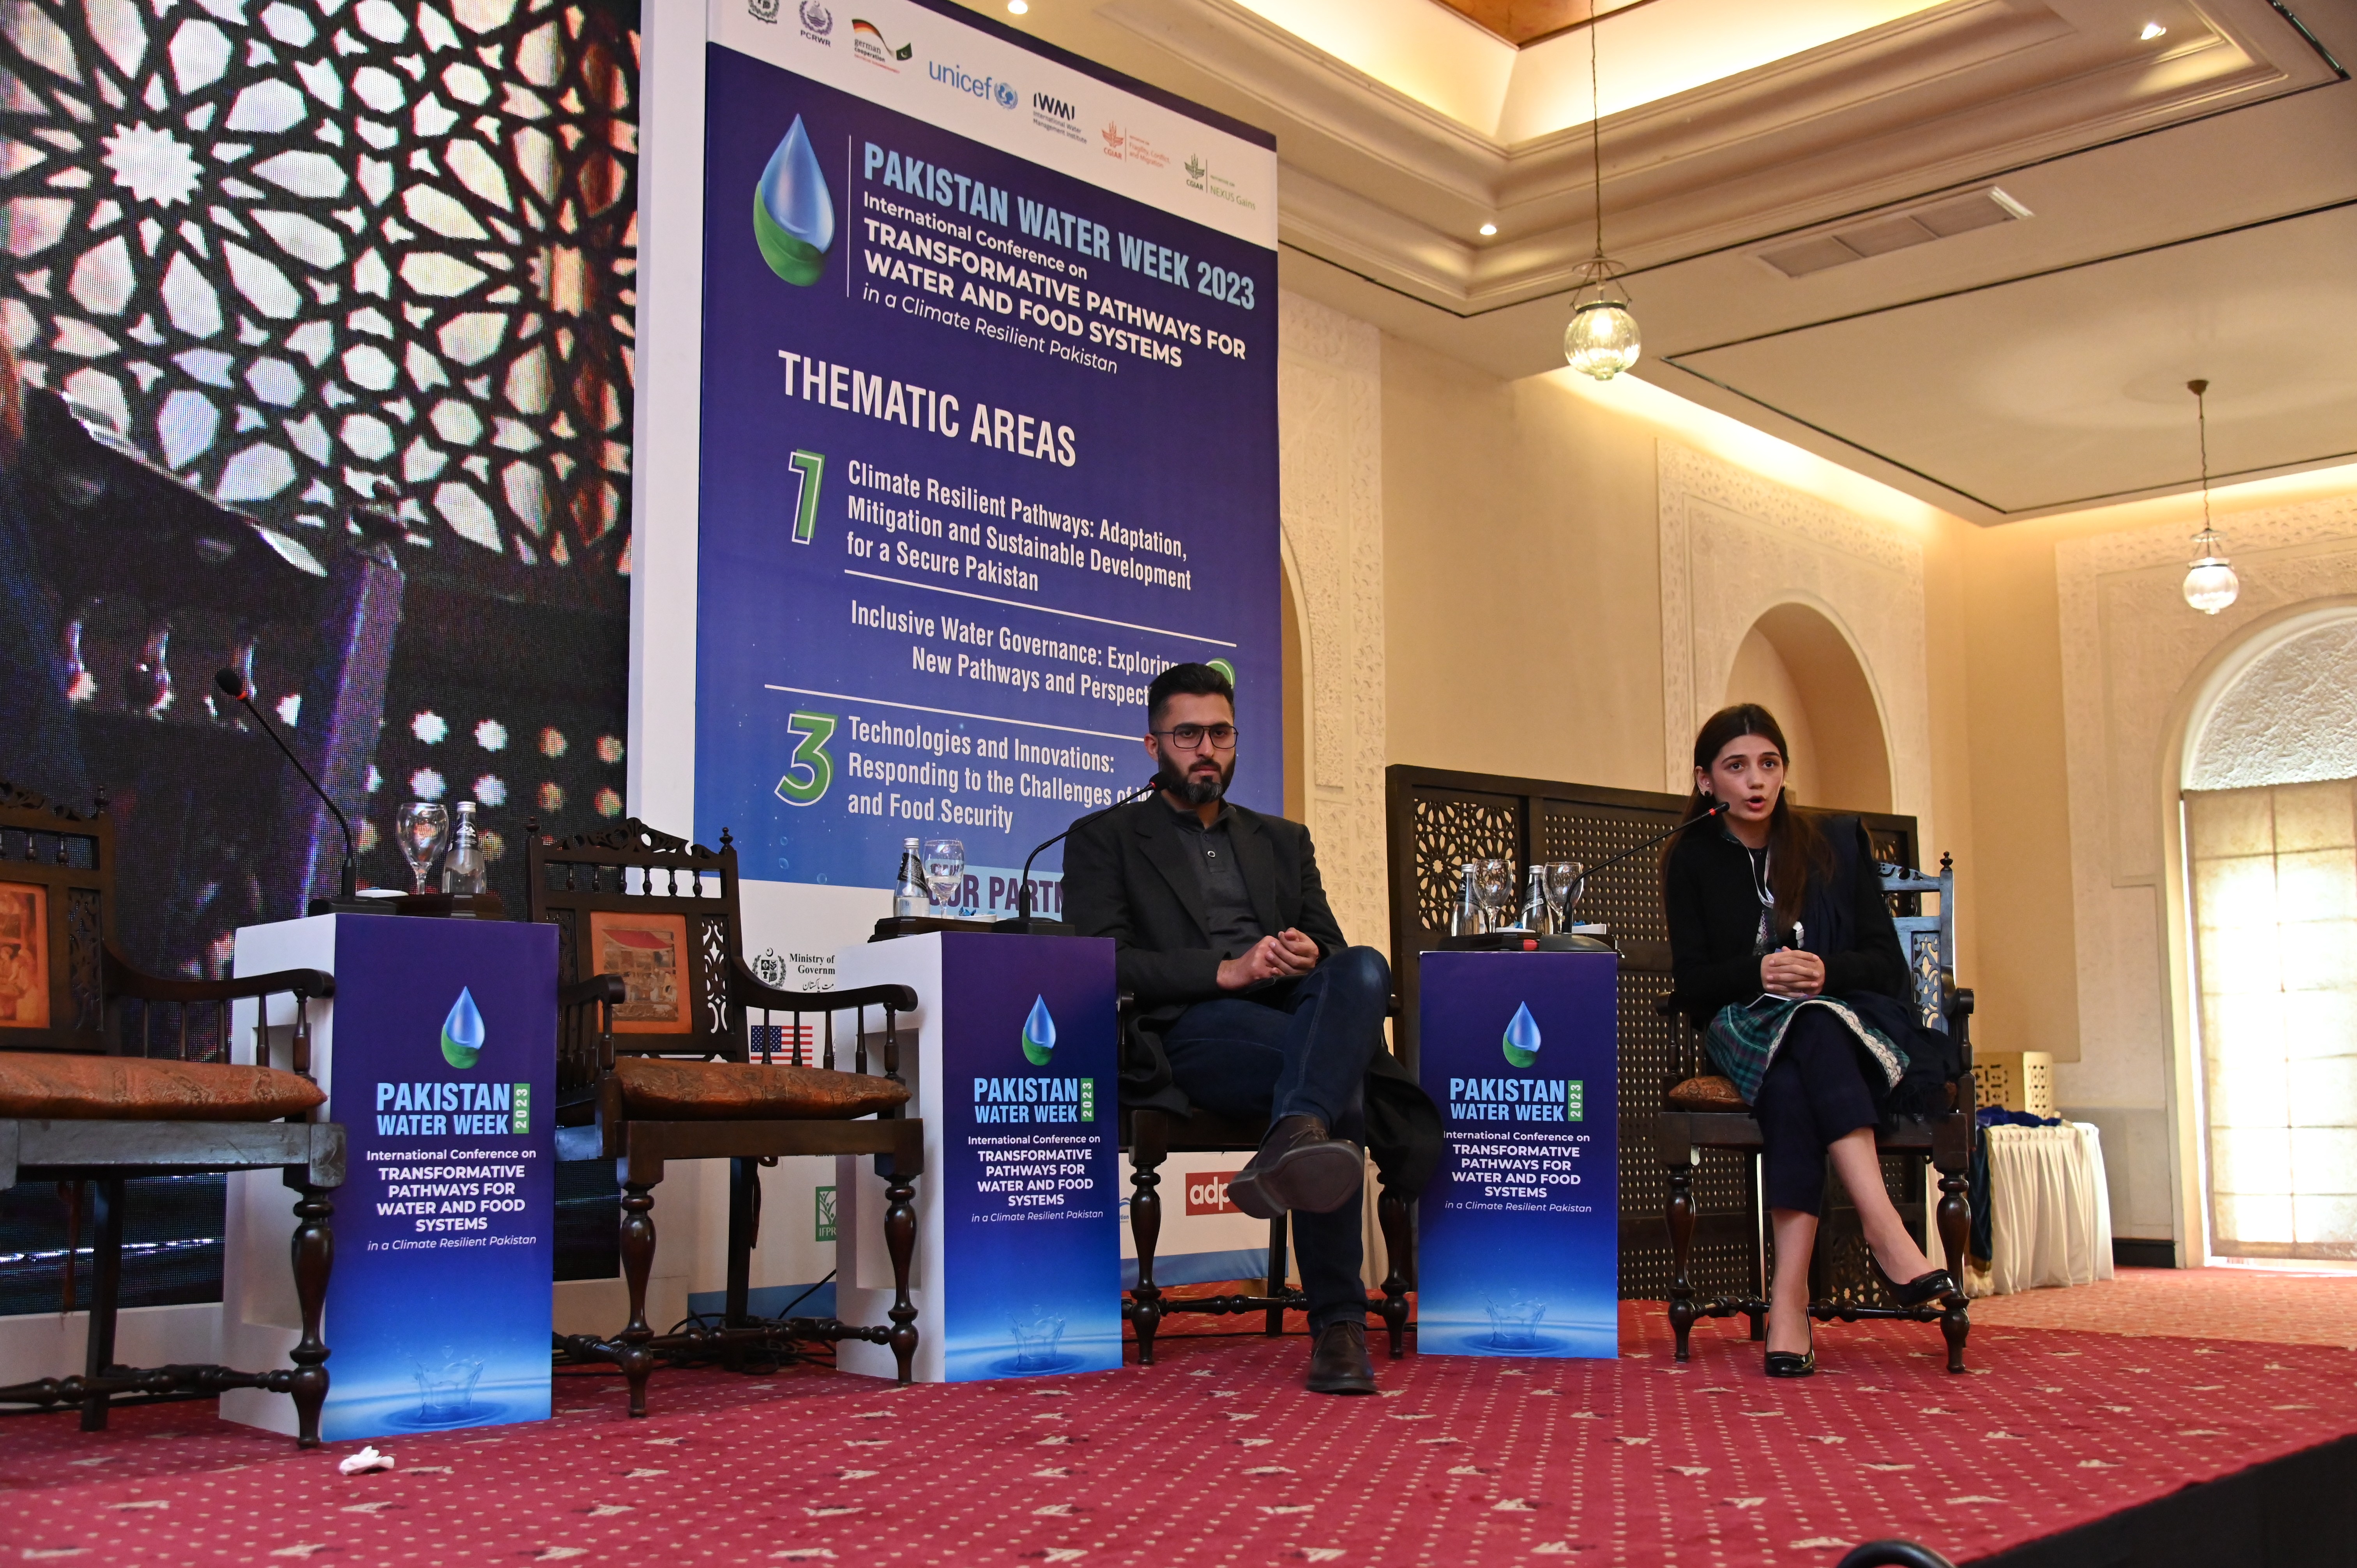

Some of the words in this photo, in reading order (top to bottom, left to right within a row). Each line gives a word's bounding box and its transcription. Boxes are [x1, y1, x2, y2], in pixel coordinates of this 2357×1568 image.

[800, 30, 831, 47] PCRWR
[855, 39, 881, 54] german
[855, 47, 885, 62] cooperation
[929, 61, 992, 100] unicef
[1034, 92, 1074, 120] IWMI
[1104, 148, 1122, 160] CGIAR
[1186, 180, 1203, 191] CGIAR
[1210, 185, 1234, 202] NEXUS
[1236, 196, 1255, 210] Gains
[865, 141, 1008, 227] PAKISTAN
[1018, 196, 1110, 261] WATER
[1118, 232, 1189, 289] WEEK
[1198, 262, 1254, 310] 2023
[864, 191, 971, 241] International
[976, 231, 1064, 272] Conference
[1069, 261, 1087, 280] on
[864, 218, 1080, 307] TRANSFORMATIVE
[1087, 291, 1201, 345] PATHWAYS
[1207, 330, 1246, 360] FOR
[864, 249, 954, 298] WATER
[961, 282, 1012, 314] AND
[1020, 299, 1083, 336] FOOD
[1090, 321, 1182, 367] SYSTEMS
[863, 283, 879, 304] in
[885, 295, 896, 308] a
[902, 296, 970, 330] Climate
[975, 317, 1045, 352] Resilient
[1050, 340, 1117, 374] Pakistan
[779, 350, 959, 438] THEMATIC
[970, 404, 1076, 467] AREAS
[789, 448, 825, 546] 1
[849, 460, 920, 499] Climate
[927, 478, 1005, 518] Resilient
[1012, 498, 1094, 539] Pathways:
[1099, 519, 1187, 562] Adaptation,
[848, 495, 942, 539] Mitigation
[949, 523, 980, 546] and
[986, 526, 1085, 568] Sustainable
[1091, 548, 1191, 591] Development
[848, 531, 873, 558] for
[880, 546, 889, 562] a
[896, 541, 959, 576] Secure
[966, 556, 1038, 592] Pakistan
[852, 600, 935, 637] Inclusive
[942, 616, 993, 646] Water
[1000, 627, 1102, 666] Governance:
[1108, 646, 1178, 676] Explorin
[913, 646, 951, 675] New
[958, 653, 1040, 692] Pathways
[1046, 672, 1074, 694] and
[848, 715, 970, 756] Technologies
[977, 737, 1007, 759] and
[1015, 738, 1114, 773] Innovations:
[774, 710, 838, 807] 3
[849, 752, 958, 793] Responding
[965, 771, 981, 791] to
[988, 770, 1013, 795] the
[1020, 773, 1111, 808] Challenges
[1117, 786, 1132, 806] of
[848, 792, 882, 816] and
[890, 793, 933, 821] Food
[942, 799, 1012, 833] Security
[790, 954, 824, 965] Ministry
[827, 955, 835, 964] of
[798, 964, 835, 975] Governm
[377, 1083, 510, 1111] PAKISTAN
[974, 1077, 1078, 1102] PAKISTAN
[1450, 1078, 1564, 1102] PAKISTAN
[516, 1088, 528, 1128] 2023
[1083, 1082, 1092, 1117] 2023
[1571, 1084, 1581, 1117] 2023
[975, 1105, 1029, 1123] WATER
[1034, 1105, 1078, 1123] WEEK
[1450, 1103, 1509, 1120] WATER
[1515, 1104, 1564, 1121] WEEK
[377, 1115, 446, 1135] WATER
[453, 1114, 509, 1135] WEEK
[968, 1135, 1030, 1144] International
[1033, 1135, 1086, 1144] Conference
[1444, 1130, 1510, 1140] International
[1513, 1132, 1574, 1141] Conference
[367, 1149, 447, 1161] International
[451, 1149, 519, 1159] Conference
[521, 1150, 536, 1158] on
[978, 1149, 1092, 1162] TRANSFORMATIVE
[1453, 1144, 1580, 1157] TRANSFORMATIVE
[378, 1165, 525, 1180] TRANSFORMATIVE
[986, 1165, 1057, 1177] PATHWAYS
[1060, 1164, 1085, 1175] FOR
[1461, 1158, 1539, 1170] PATHWAYS
[1543, 1160, 1571, 1171] FOR
[977, 1181, 1023, 1192] WATER
[1027, 1179, 1055, 1191] AND
[1058, 1179, 1093, 1190] FOOD
[1452, 1172, 1502, 1183] WATER
[1505, 1173, 1536, 1183] AND
[1541, 1174, 1581, 1185] FOOD
[389, 1183, 479, 1198] PATHWAYS
[484, 1182, 515, 1195] FOR
[1484, 1187, 1547, 1198] SYSTEMS
[376, 1202, 436, 1215] WATER
[440, 1201, 476, 1214] AND
[481, 1199, 525, 1213] FOOD
[1008, 1194, 1064, 1206] SYSTEMS
[1445, 1201, 1453, 1209] in
[1465, 1202, 1502, 1210] Climate
[1506, 1202, 1546, 1211] Resilient
[1549, 1204, 1592, 1212] Pakistan
[415, 1217, 488, 1232] SYSTEMS
[972, 1213, 979, 1222] in
[991, 1212, 1025, 1222] Climate
[1027, 1211, 1064, 1220] Resilient
[1067, 1210, 1103, 1218] Pakistan
[368, 1241, 378, 1251] in
[392, 1238, 437, 1250] Climate
[440, 1237, 487, 1247] Resilient
[490, 1235, 536, 1245] Pakistan
